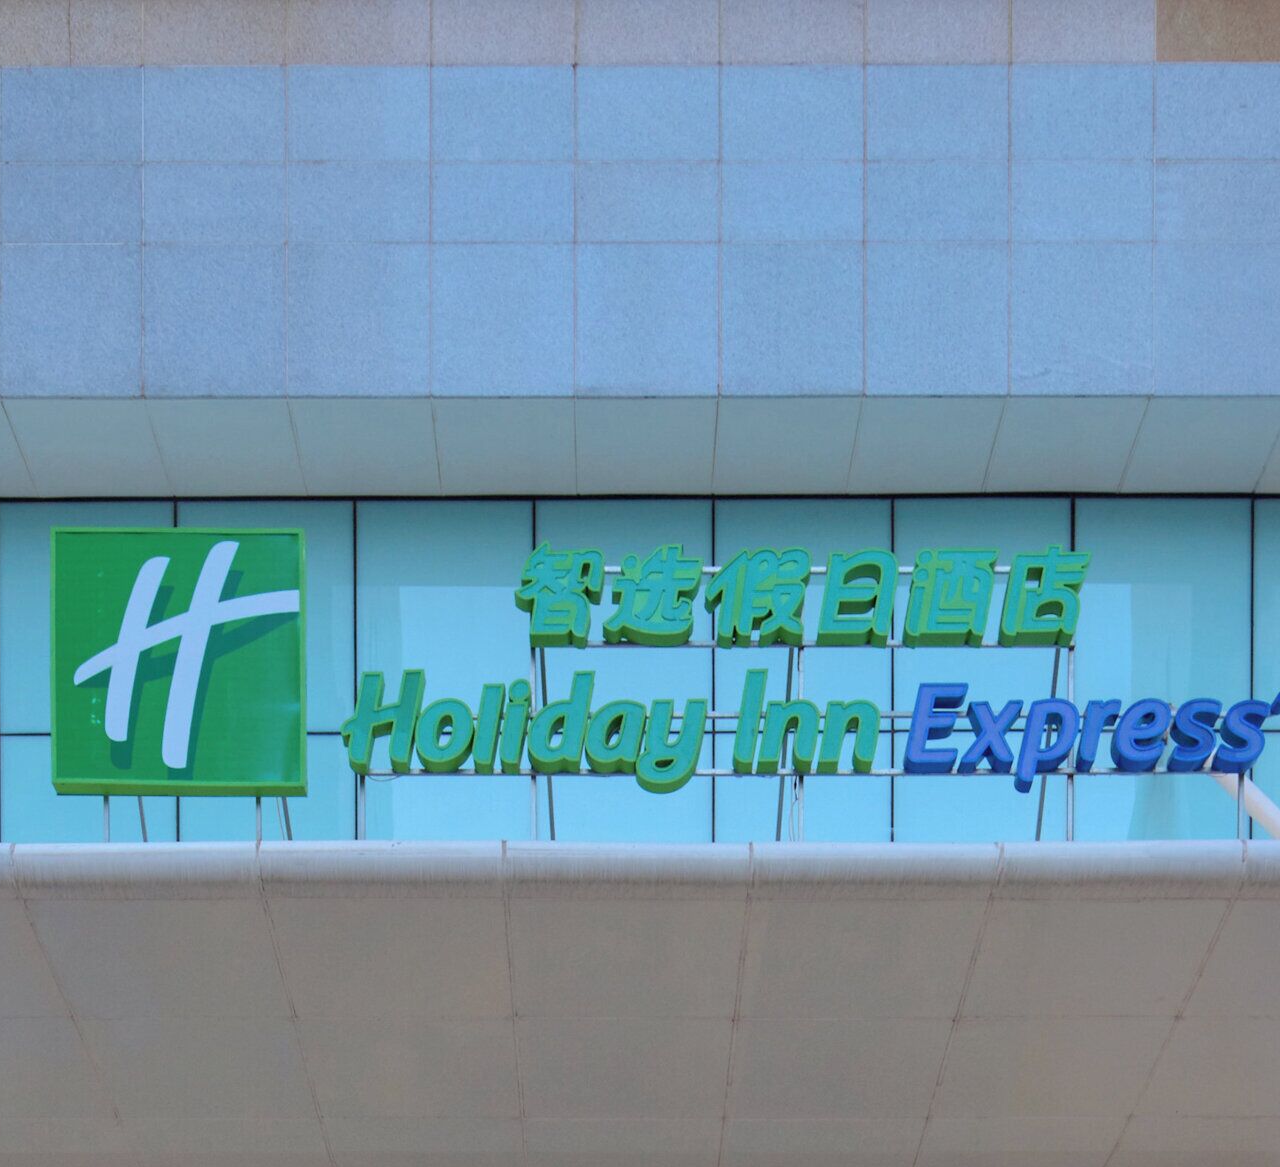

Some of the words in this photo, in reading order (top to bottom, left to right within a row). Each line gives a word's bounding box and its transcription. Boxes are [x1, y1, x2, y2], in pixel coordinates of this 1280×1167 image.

[516, 540, 1091, 649] 智选假日酒店
[341, 668, 707, 794] Holiday
[732, 668, 880, 774] Inn
[903, 682, 1270, 793] Express
